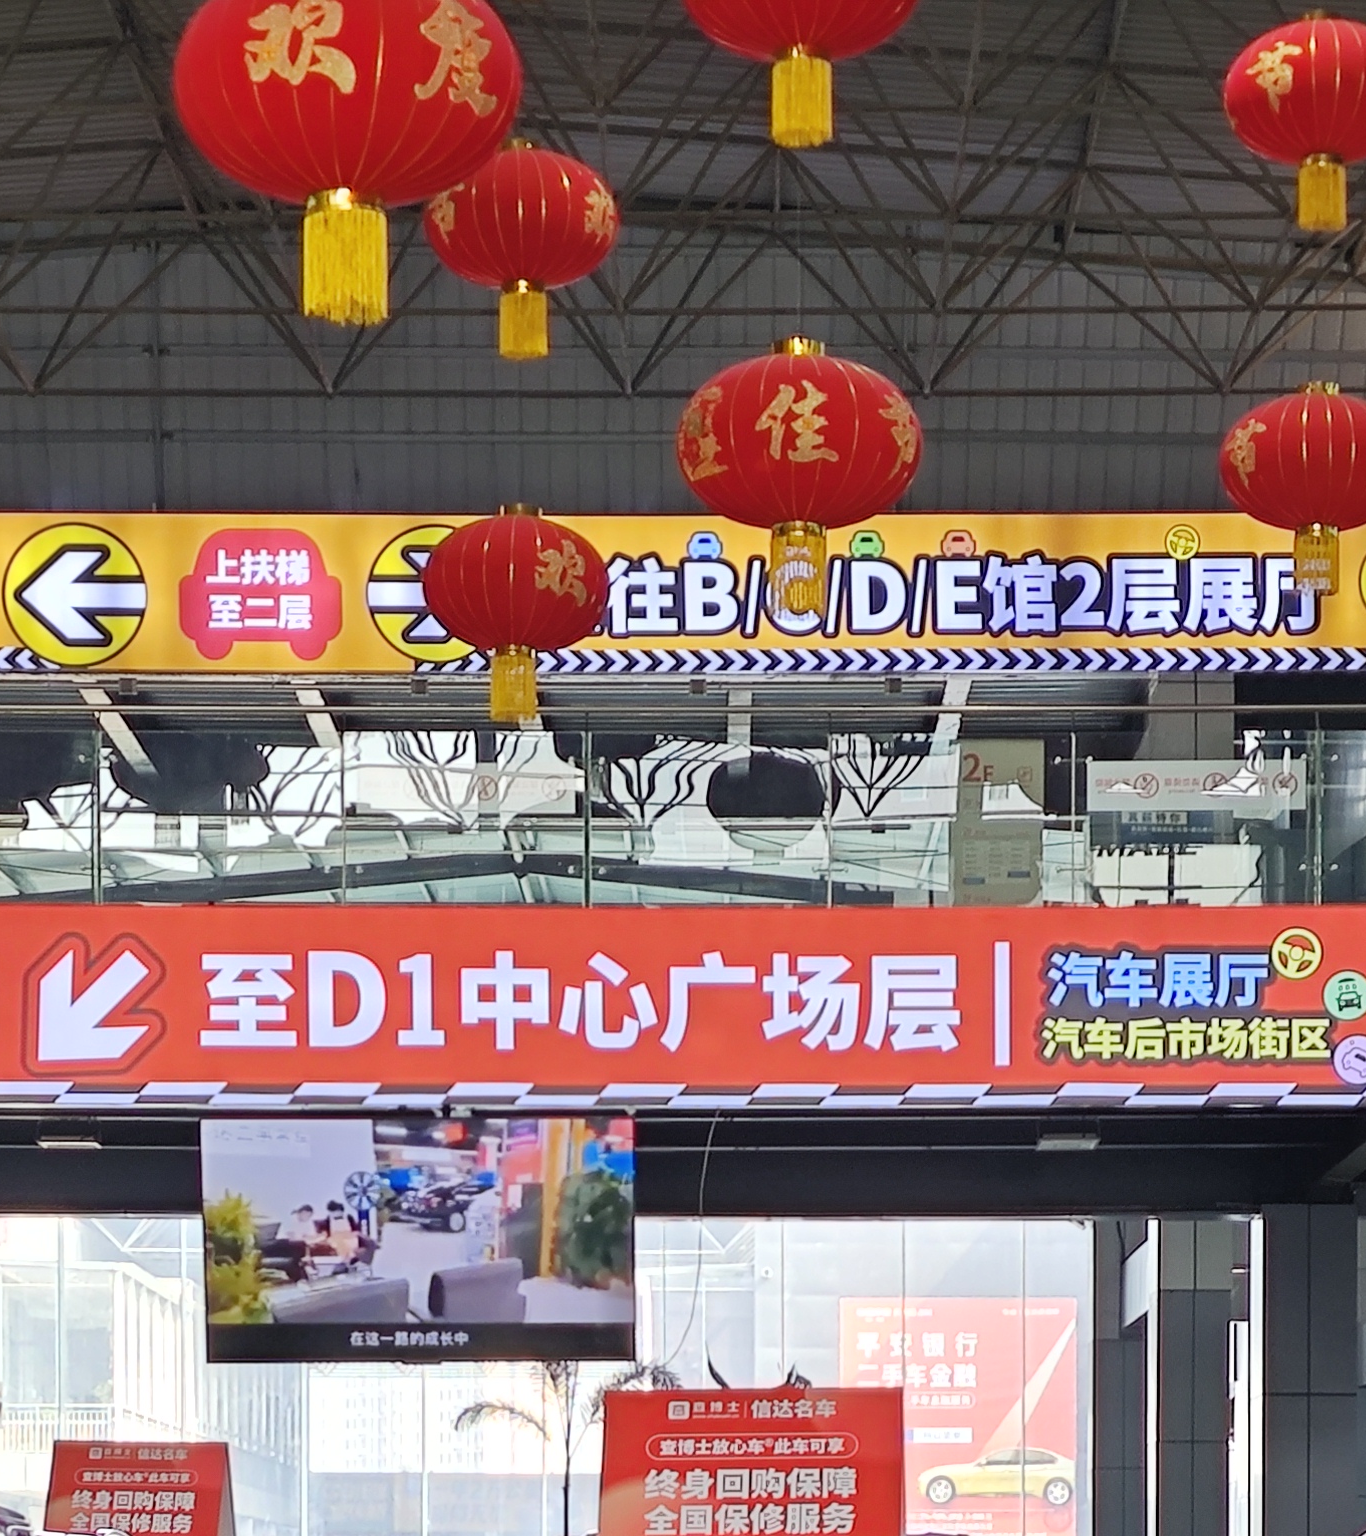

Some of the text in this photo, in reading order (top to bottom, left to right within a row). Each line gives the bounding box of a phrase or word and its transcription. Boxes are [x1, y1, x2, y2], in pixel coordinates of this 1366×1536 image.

[206, 549, 311, 589] 上扶梯
[593, 552, 1319, 637] 往B/C/D/E馆2层展厅
[208, 594, 313, 633] 至二层
[1046, 950, 1270, 1008] 汽车展厅
[199, 949, 963, 1053] 至D1中心广场层
[1041, 1016, 1332, 1061] 汽车后市场街区
[856, 1331, 978, 1359] 平安银行
[857, 1362, 978, 1389] 二手车金融
[750, 1399, 837, 1419] 信达名车
[643, 1466, 858, 1499] 终身回购保障
[70, 1489, 196, 1512] 终身回购保障
[69, 1511, 194, 1535] 全国保修服务
[643, 1503, 857, 1536] 全国保修服务
